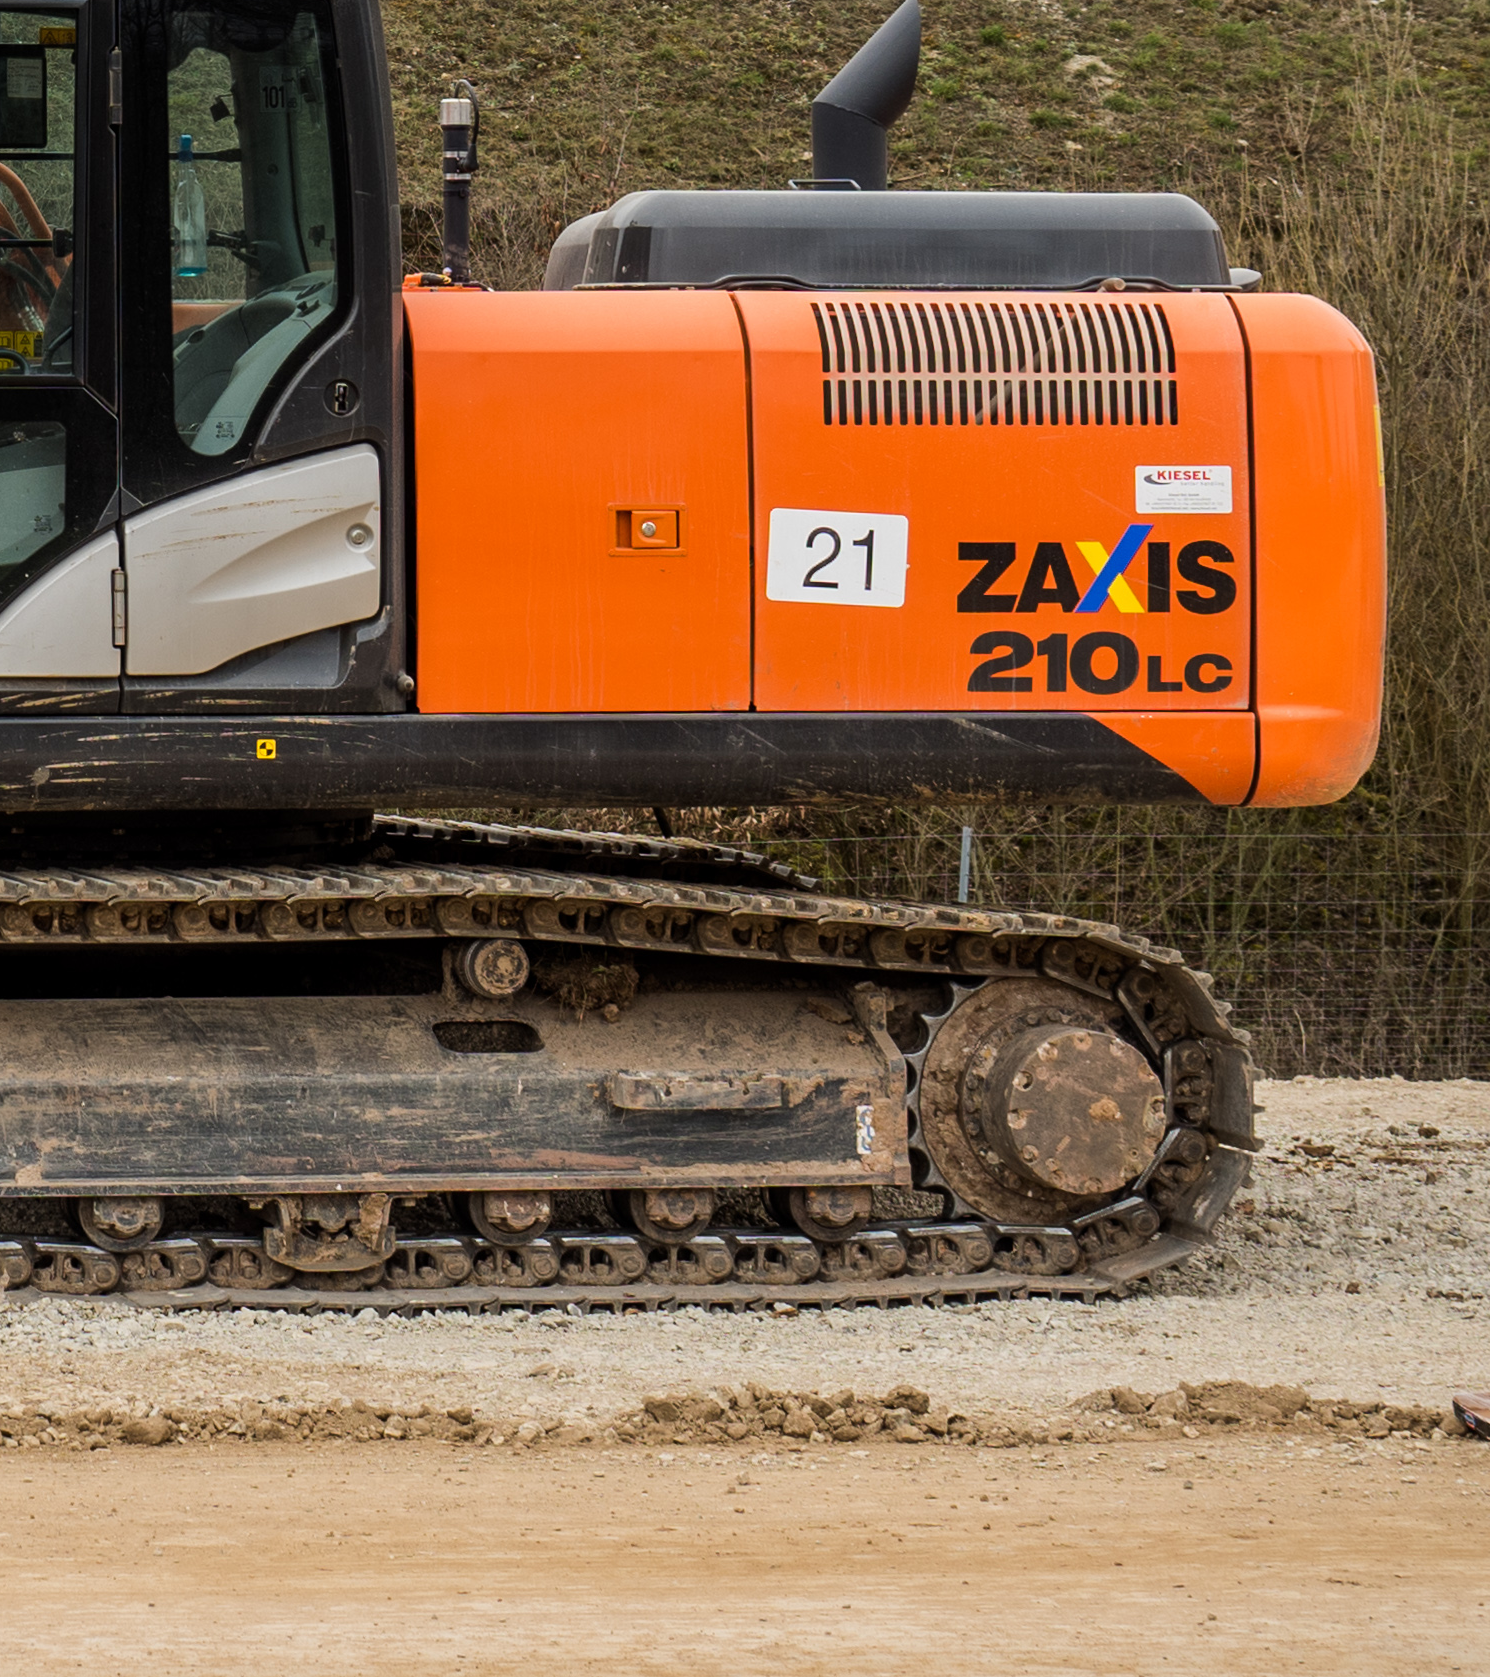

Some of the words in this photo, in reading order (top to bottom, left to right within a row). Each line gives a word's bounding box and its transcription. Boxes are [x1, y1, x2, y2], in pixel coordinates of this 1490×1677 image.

[262, 85, 285, 109] 101
[1157, 470, 1211, 480] KIESEL
[802, 526, 875, 591] 21
[956, 524, 1238, 615] ZAXIS
